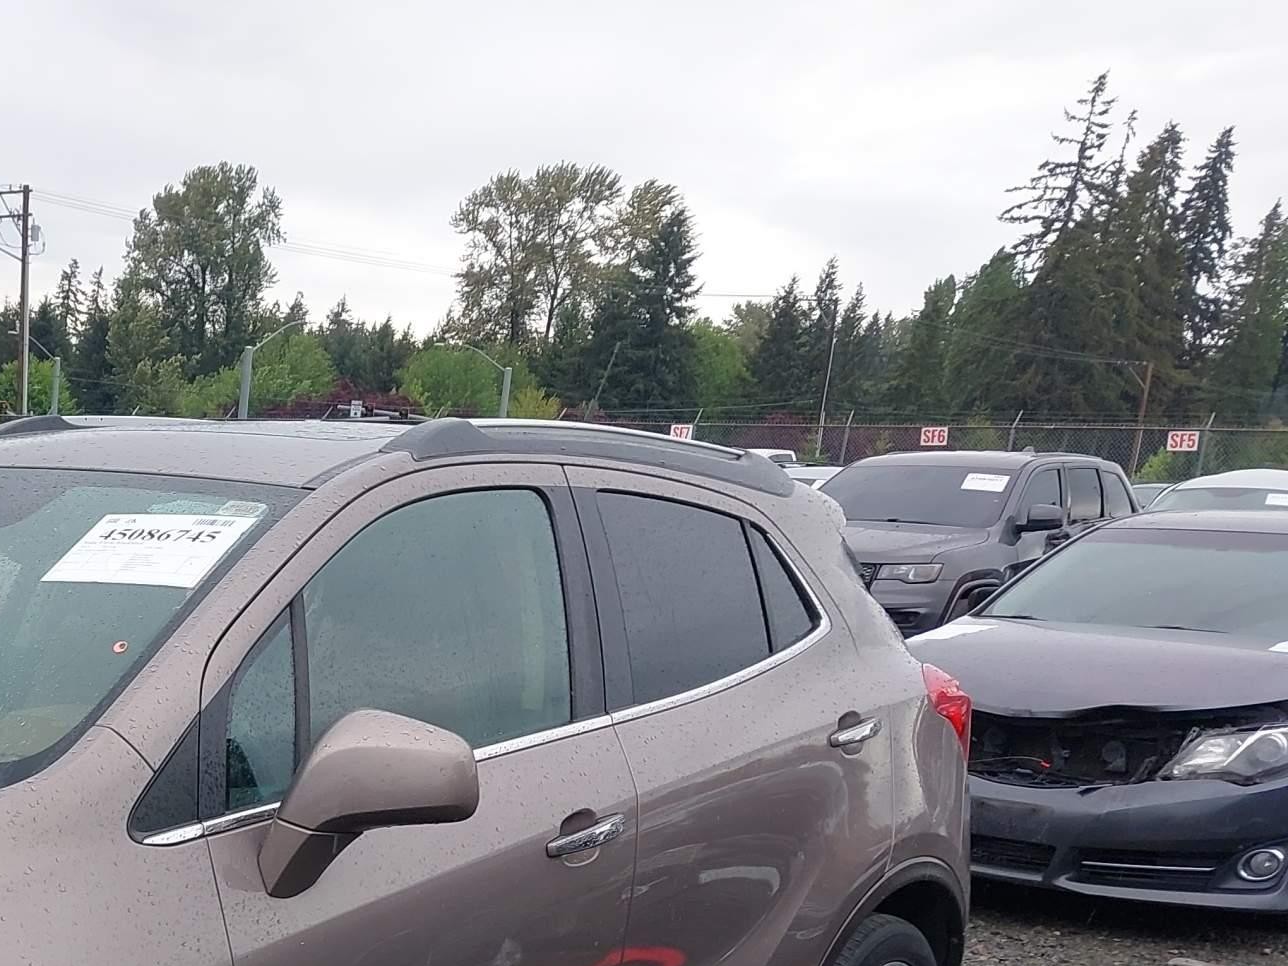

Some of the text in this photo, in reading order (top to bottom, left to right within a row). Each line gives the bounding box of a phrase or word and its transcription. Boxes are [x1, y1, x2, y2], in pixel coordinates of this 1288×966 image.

[923, 429, 946, 443] SF6
[1170, 433, 1196, 448] SF5
[99, 528, 221, 543] 45086745
